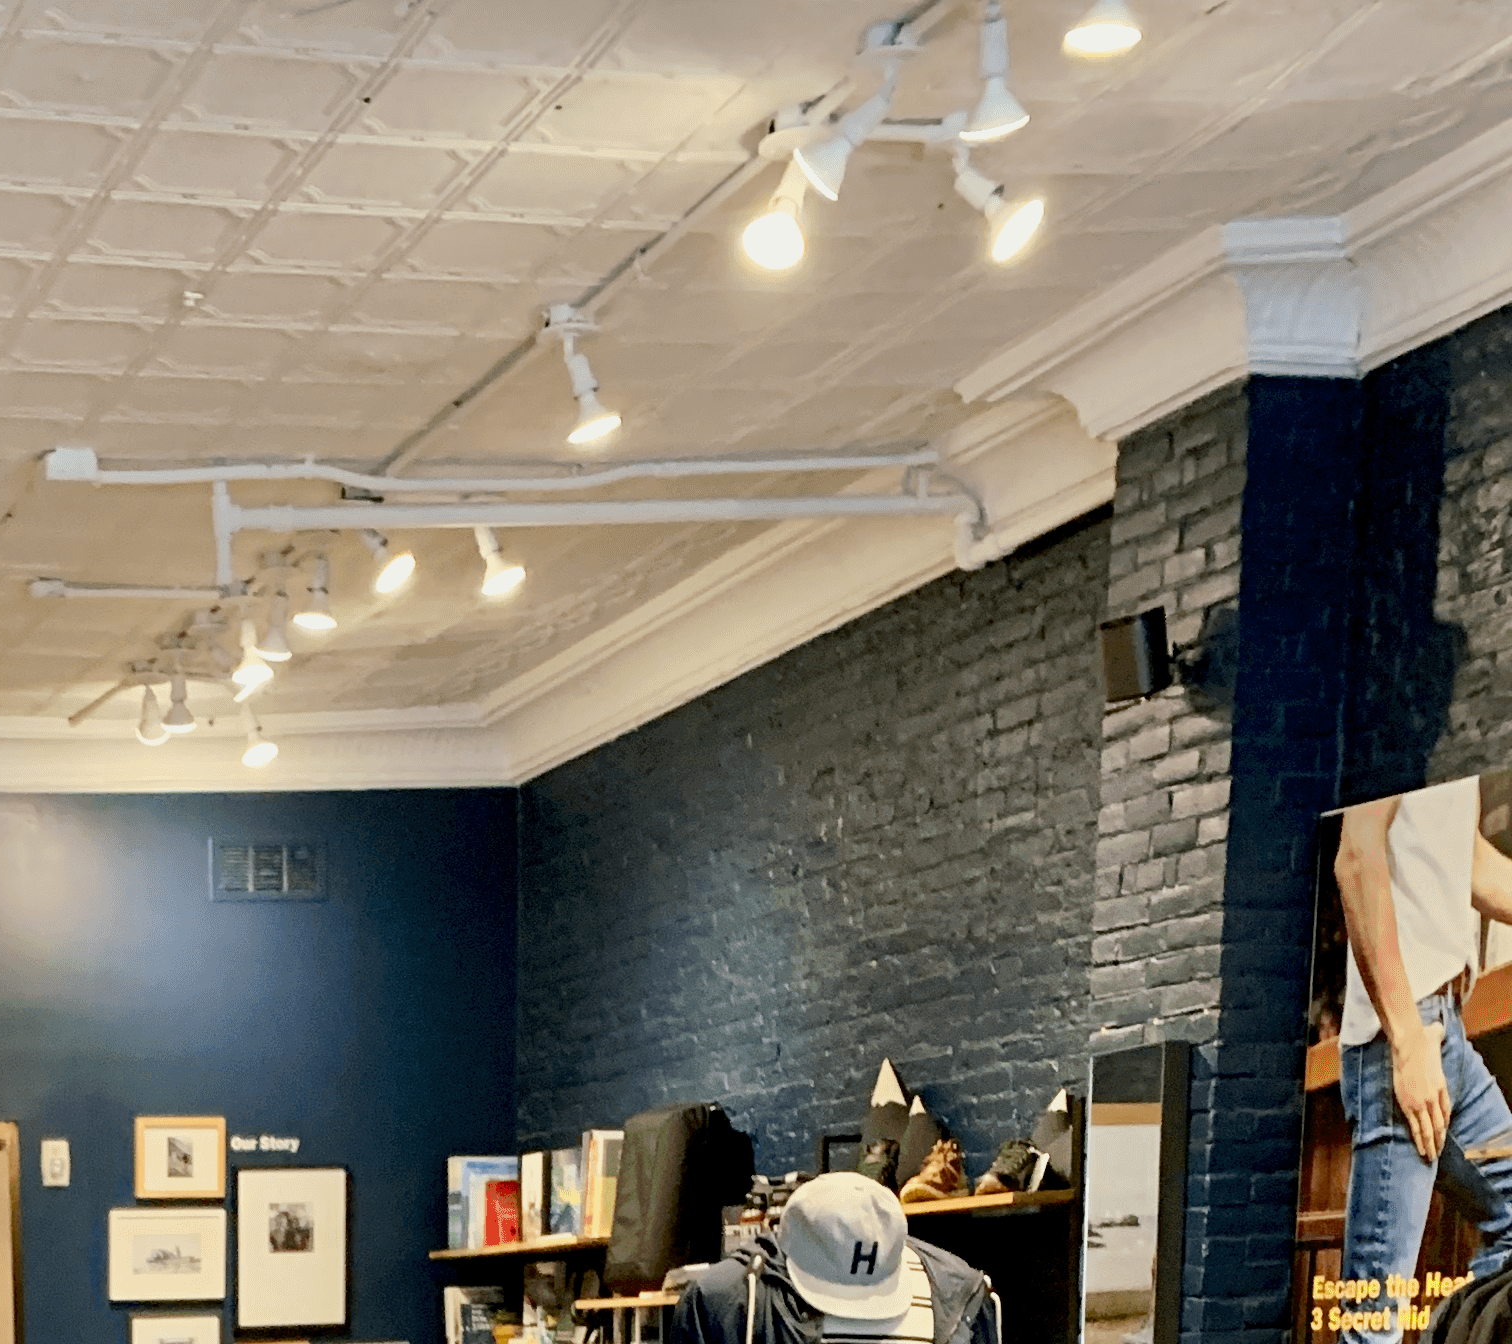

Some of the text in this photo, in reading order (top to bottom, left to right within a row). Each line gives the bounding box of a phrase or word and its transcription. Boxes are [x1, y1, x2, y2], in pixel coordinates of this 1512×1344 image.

[229, 1134, 300, 1153] Our Story
[849, 1240, 879, 1275] H
[1312, 1274, 1381, 1304] Escape
[1386, 1272, 1420, 1298] the
[1310, 1306, 1323, 1331] 3
[1327, 1305, 1391, 1332] Secret
